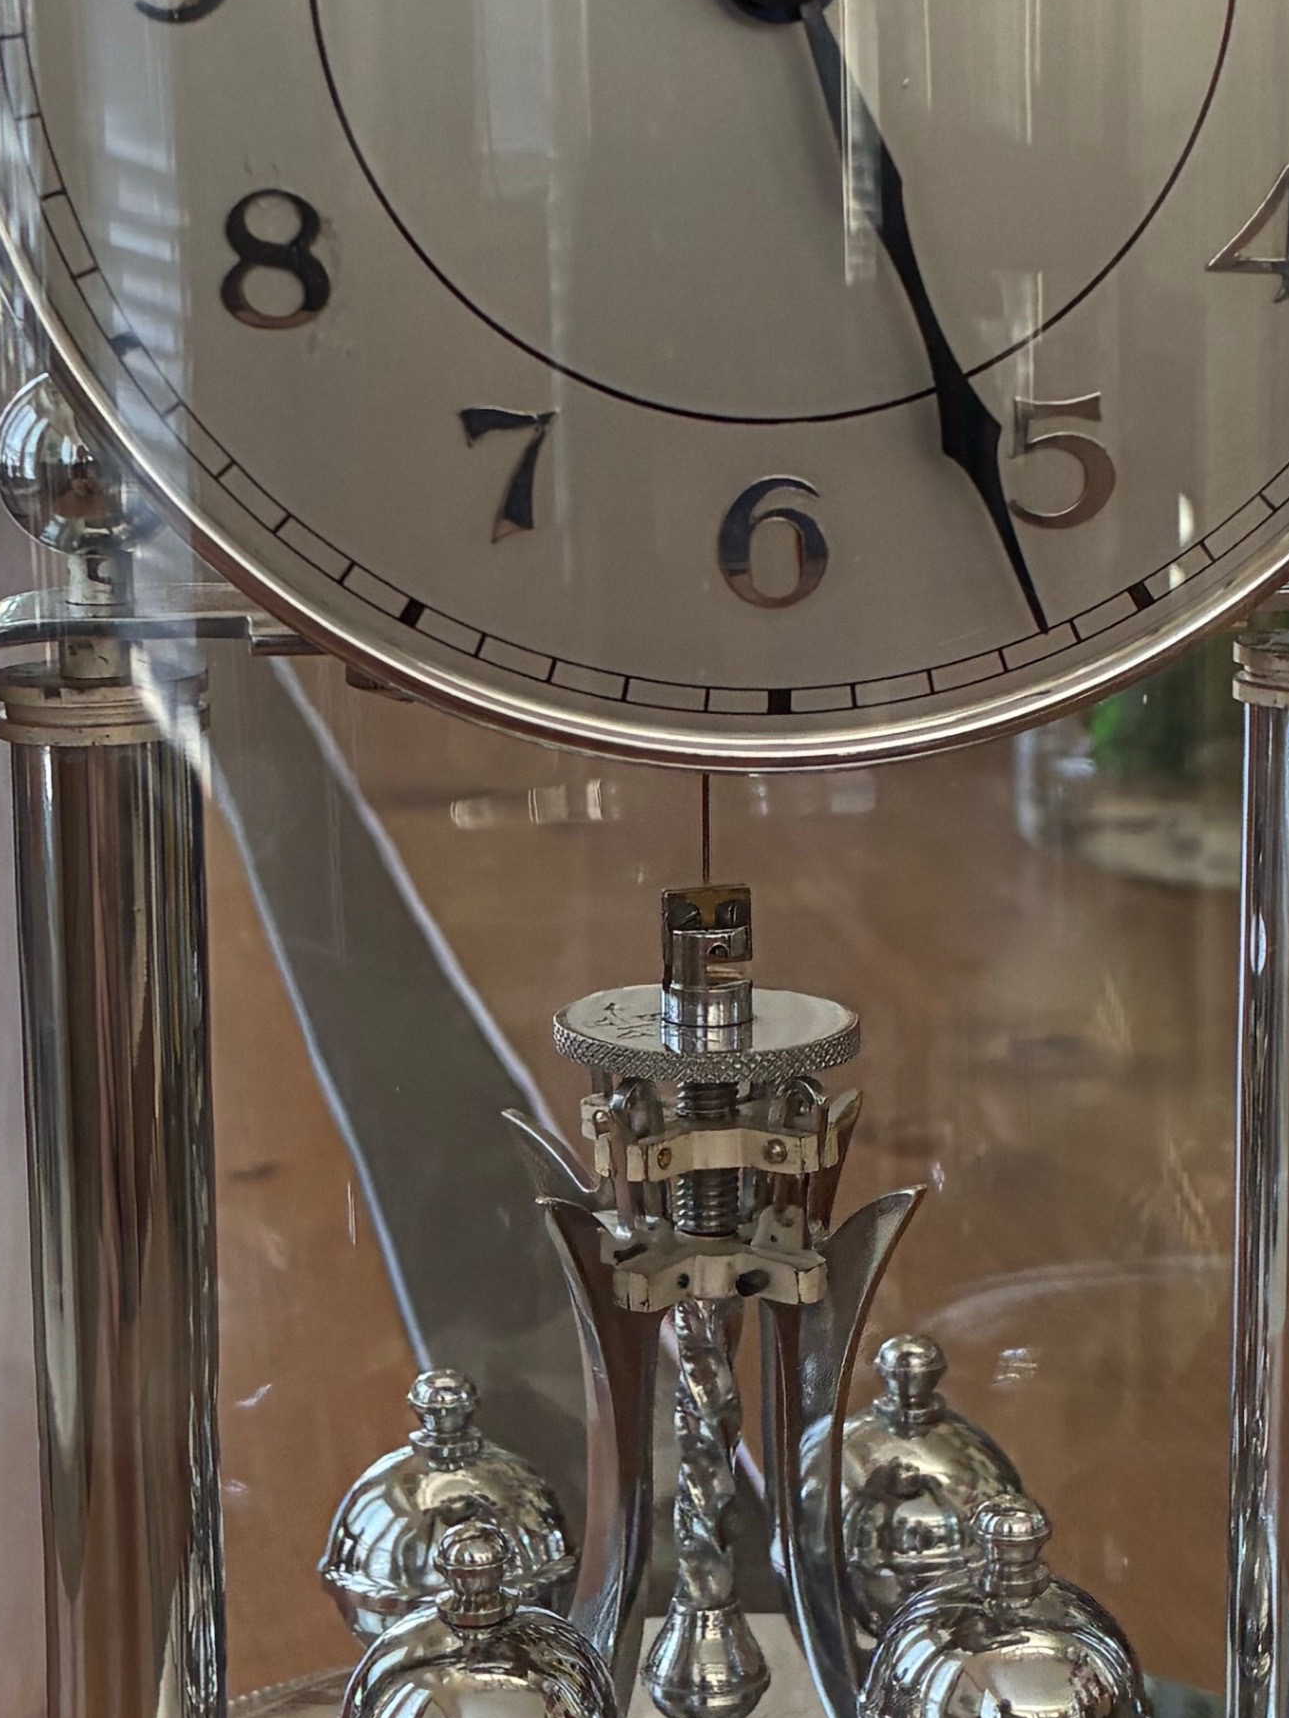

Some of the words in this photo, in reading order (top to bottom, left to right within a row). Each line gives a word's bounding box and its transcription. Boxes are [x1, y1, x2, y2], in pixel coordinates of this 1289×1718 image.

[221, 187, 332, 330] 8
[459, 405, 557, 544] 7
[1009, 392, 1116, 528] 5
[716, 476, 829, 609] 6
